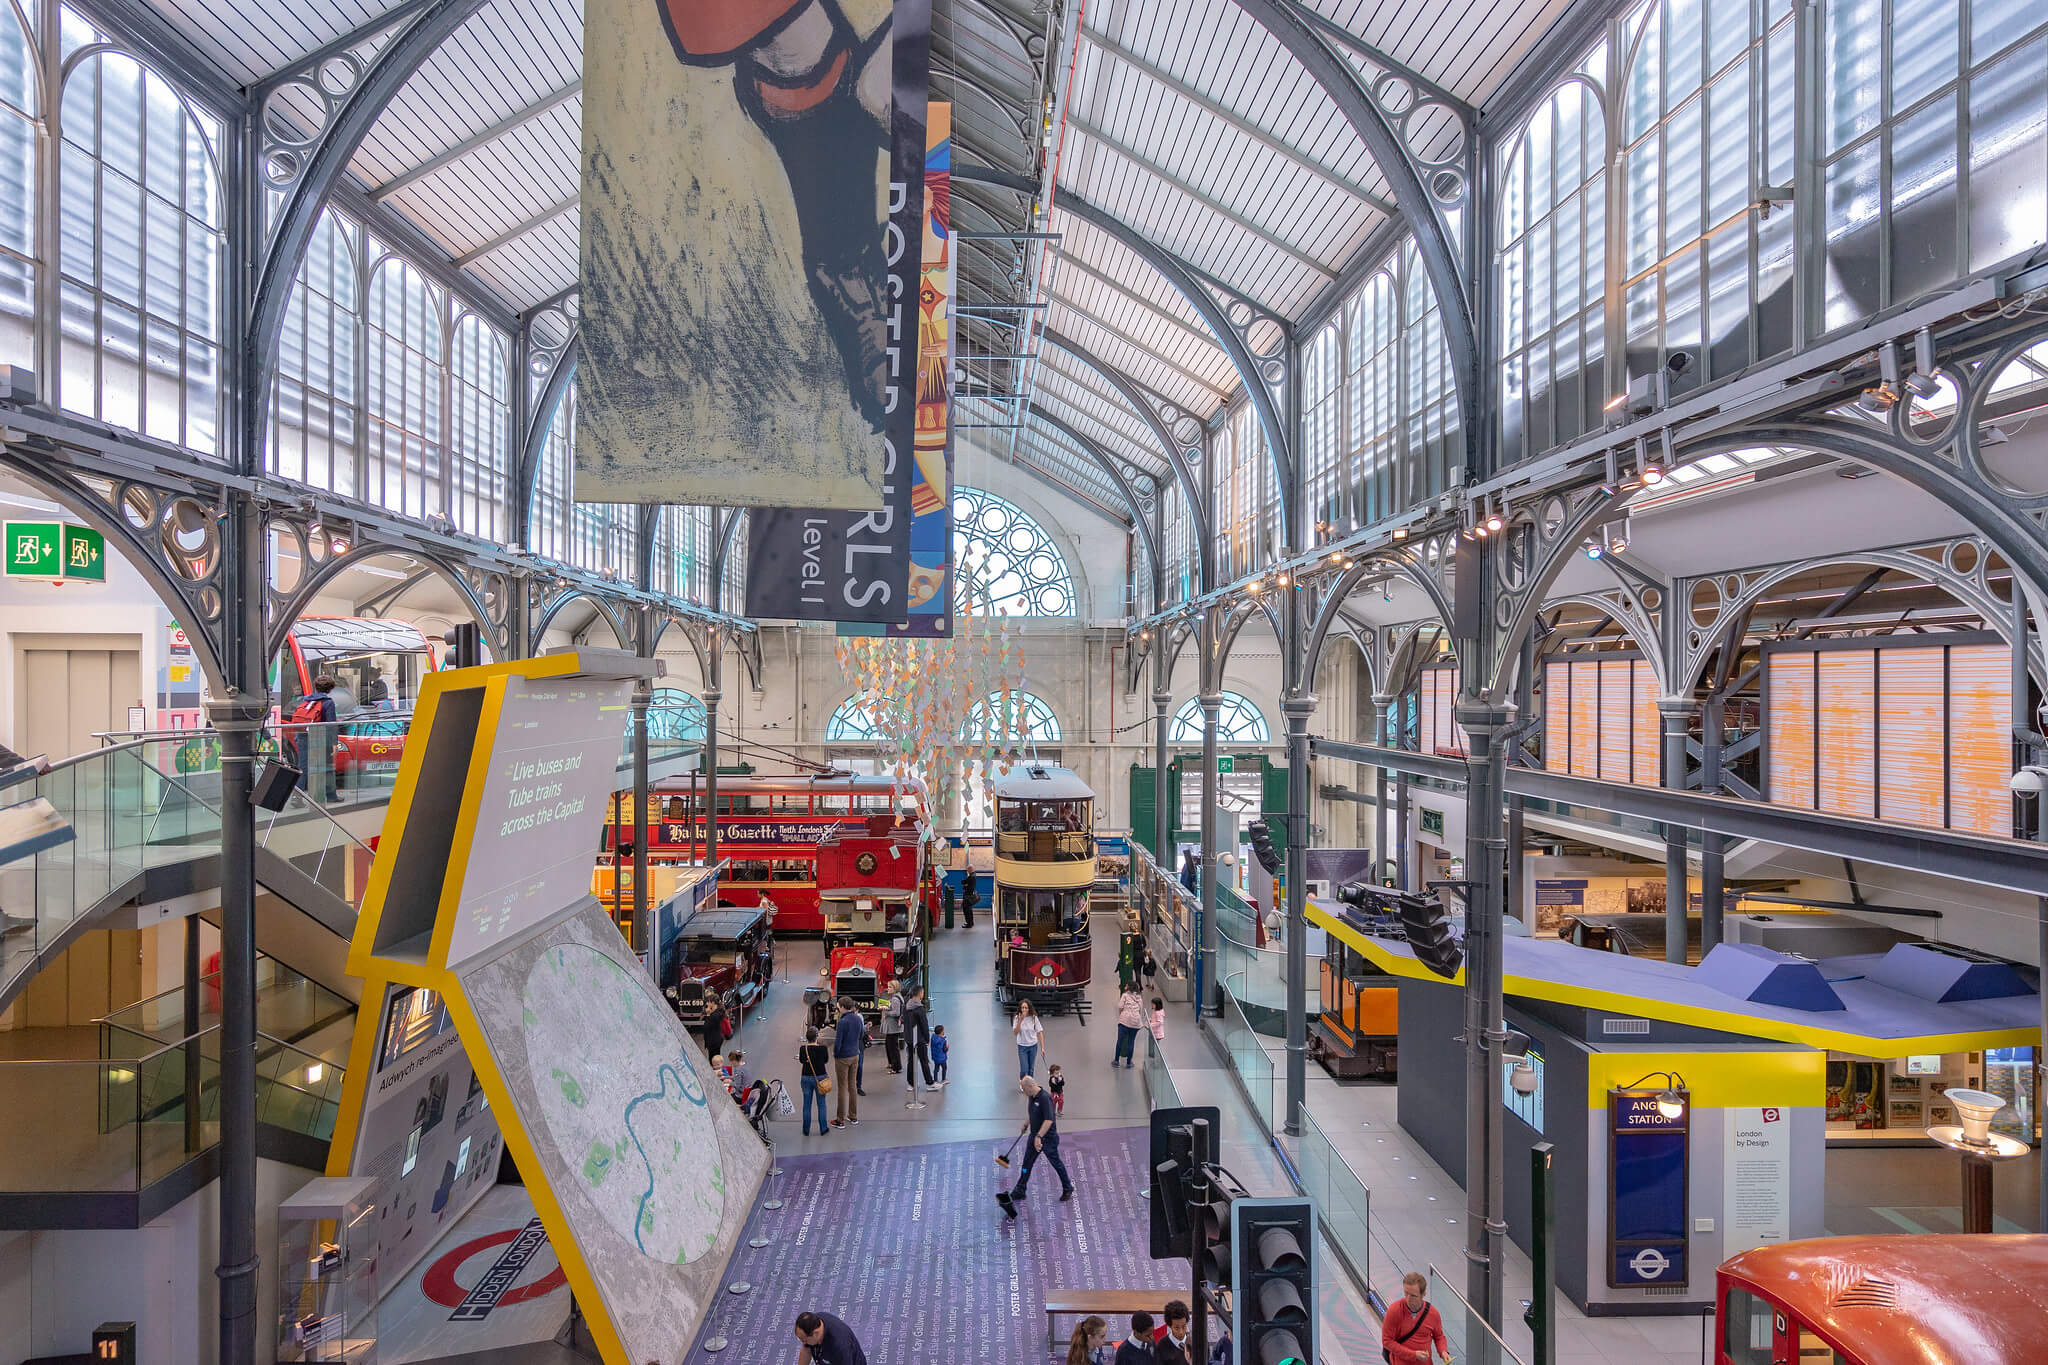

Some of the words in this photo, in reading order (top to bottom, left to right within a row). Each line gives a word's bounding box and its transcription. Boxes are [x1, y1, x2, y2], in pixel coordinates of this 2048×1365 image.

[801, 518, 828, 589] level
[370, 742, 388, 754] Go
[512, 761, 535, 781] Live
[536, 758, 564, 777] buses
[564, 751, 583, 771] and
[508, 787, 534, 809] Tube
[535, 780, 562, 802] trains
[500, 813, 535, 836] across
[536, 806, 553, 825] the
[554, 795, 586, 821] Capital
[728, 824, 777, 840] Gazette
[779, 825, 796, 834] North
[1385, 880, 1392, 888] 6
[1126, 936, 1131, 944] 9
[379, 1061, 415, 1093] Aldwych
[1628, 1114, 1673, 1125] STATION
[1736, 1130, 1763, 1138] London
[1736, 1139, 1744, 1147] by
[1746, 1138, 1770, 1148] Design
[1546, 1153, 1552, 1169] 1
[914, 1190, 923, 1203] GIRLS
[912, 1204, 921, 1221] POSTER
[1075, 1219, 1084, 1233] GIRLS
[1078, 1234, 1088, 1253] POSTER
[1010, 1248, 1018, 1273] exhibition
[1081, 1255, 1091, 1276] Rhodes
[1053, 1260, 1064, 1284] Parsons
[856, 1280, 868, 1303] Victoria
[1010, 1274, 1019, 1291] GIRLS
[452, 1269, 510, 1320] HIDDEN
[963, 1286, 975, 1314] Margaret
[1026, 1288, 1035, 1303] Marx
[1011, 1292, 1021, 1316] POSTER
[1026, 1304, 1037, 1319] Enid
[768, 1305, 784, 1331] Daphne
[913, 1309, 927, 1337] Gallwey
[947, 1306, 959, 1333] Huntley
[980, 1313, 989, 1337] Kessell
[996, 1307, 1006, 1325] Scott
[881, 1321, 892, 1336] Ellis
[963, 1317, 975, 1345] Jackson
[912, 1339, 925, 1351] Kay
[928, 1338, 939, 1355] Elsie
[946, 1334, 956, 1343] Su
[98, 1340, 118, 1359] 11
[876, 1337, 889, 1364] Edwina
[979, 1339, 991, 1357] Mary
